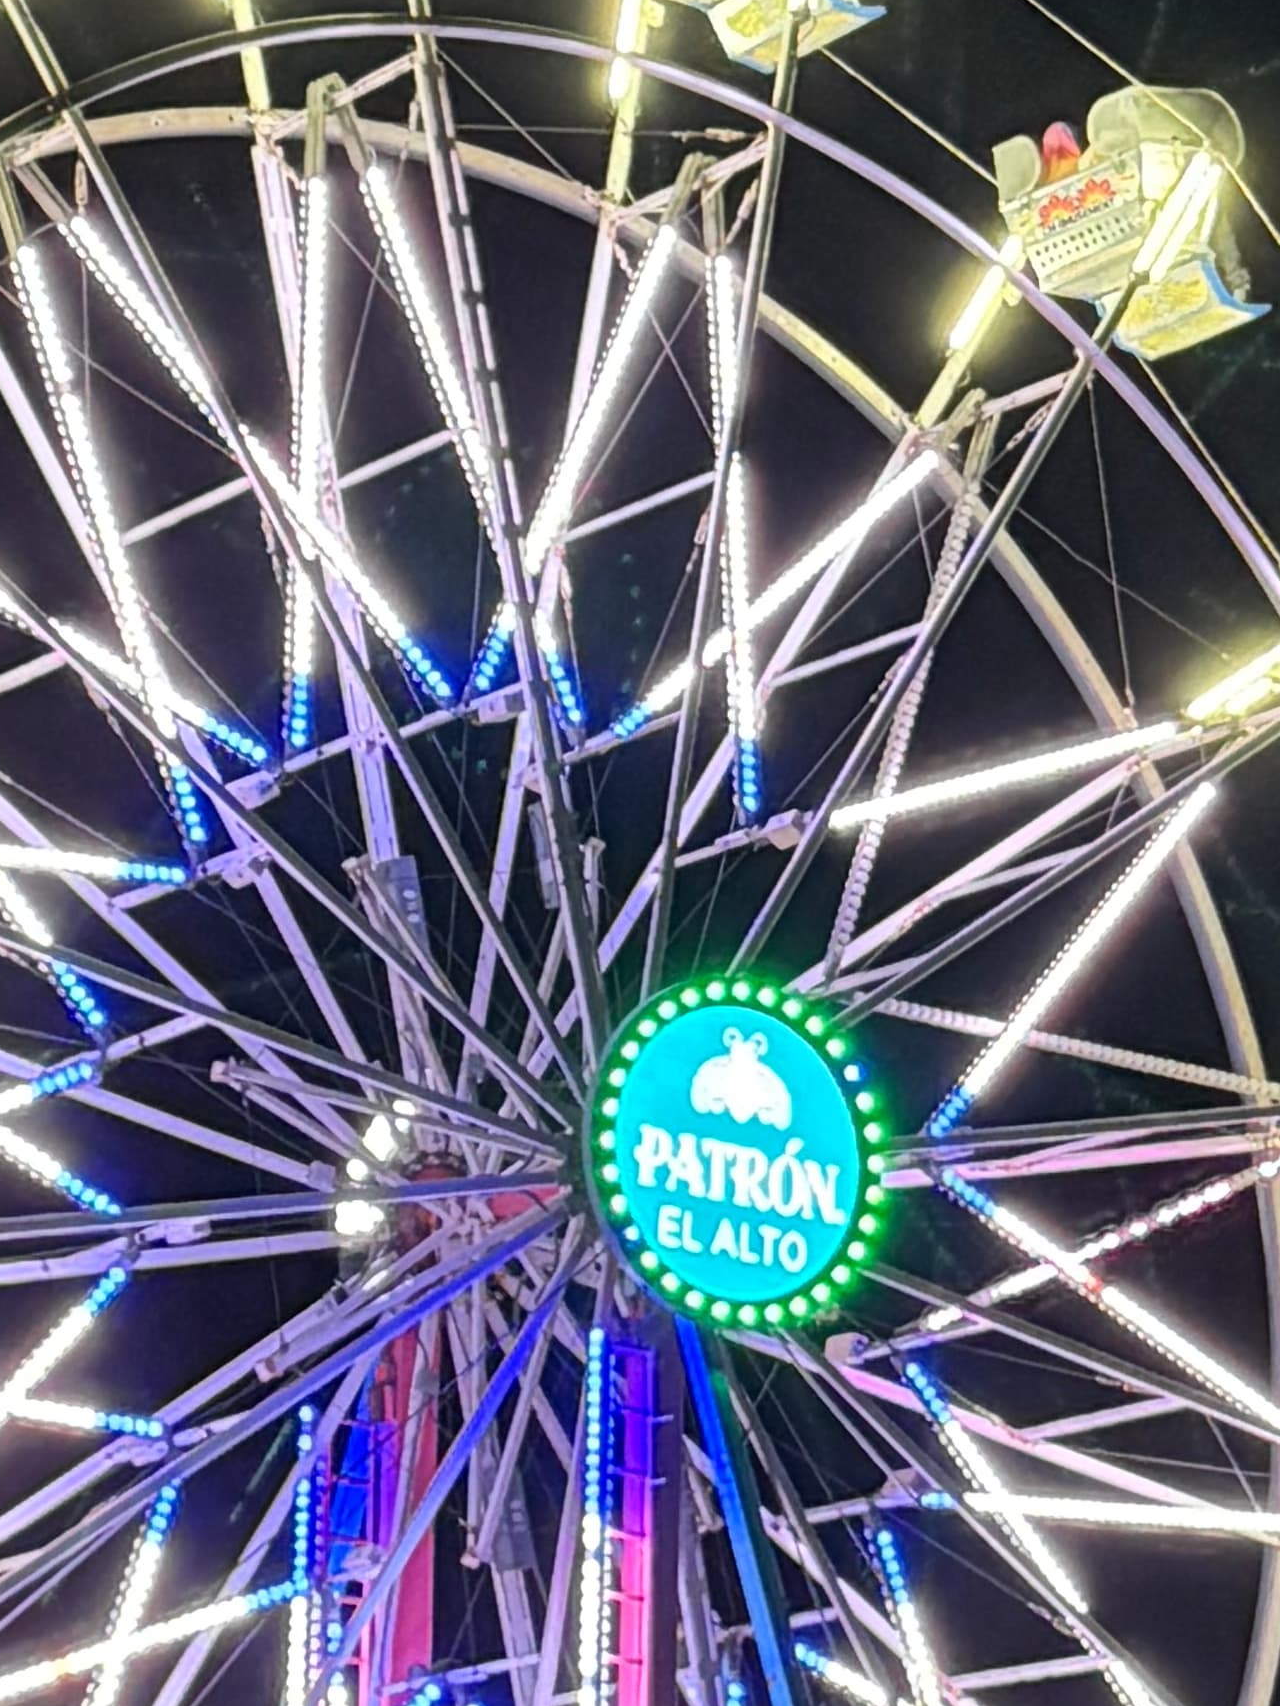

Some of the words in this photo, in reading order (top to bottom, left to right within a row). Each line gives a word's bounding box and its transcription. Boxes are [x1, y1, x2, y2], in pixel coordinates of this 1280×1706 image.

[634, 1123, 847, 1225] PATRÓN
[657, 1205, 703, 1253] EL
[711, 1218, 808, 1273] ALTO
